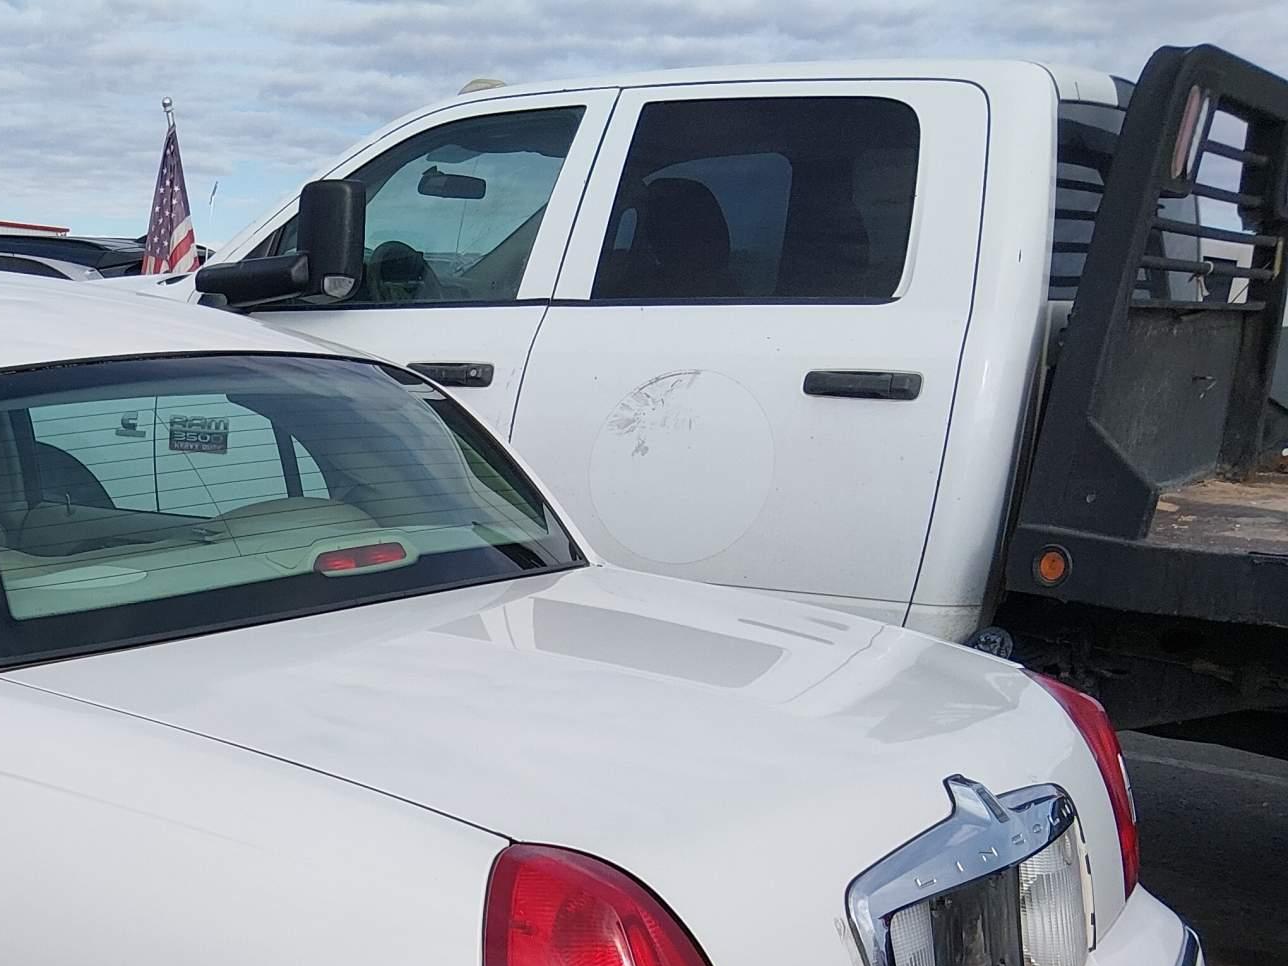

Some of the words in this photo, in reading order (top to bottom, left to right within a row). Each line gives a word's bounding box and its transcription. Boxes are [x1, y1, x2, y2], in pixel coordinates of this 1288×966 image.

[170, 415, 230, 431] RAM
[173, 431, 225, 443] 3500
[914, 801, 1073, 889] LINCOLN
